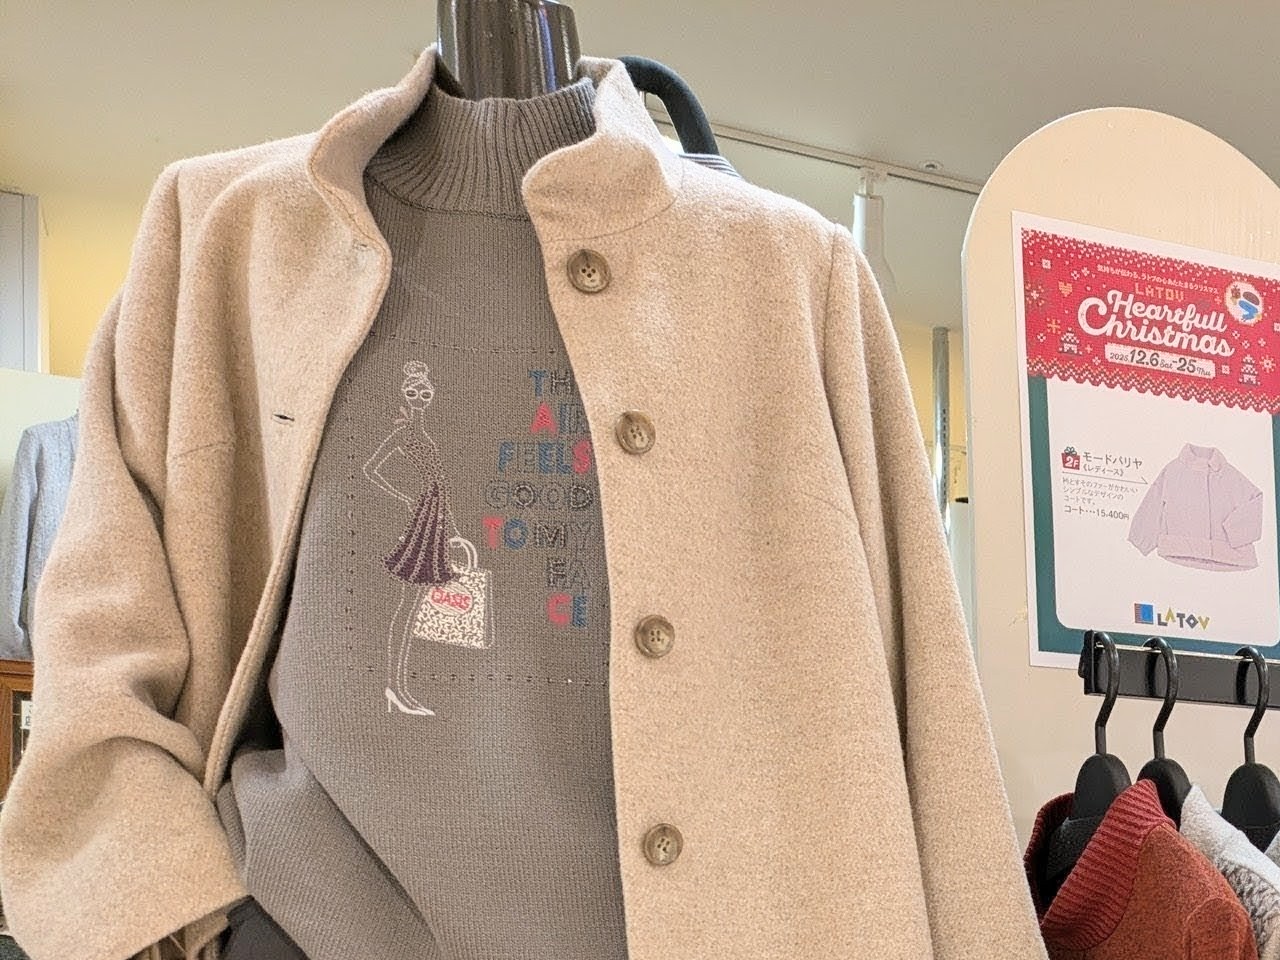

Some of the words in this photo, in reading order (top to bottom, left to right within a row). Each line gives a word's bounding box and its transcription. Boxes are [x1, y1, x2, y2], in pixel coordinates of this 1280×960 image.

[1077, 296, 1236, 357] Christmas
[1107, 289, 1228, 333] Heartfull
[498, 440, 592, 475] FEELS
[1064, 456, 1079, 468] 2F
[484, 482, 594, 511] GOOD
[482, 516, 528, 550] TO
[547, 592, 588, 628] CE
